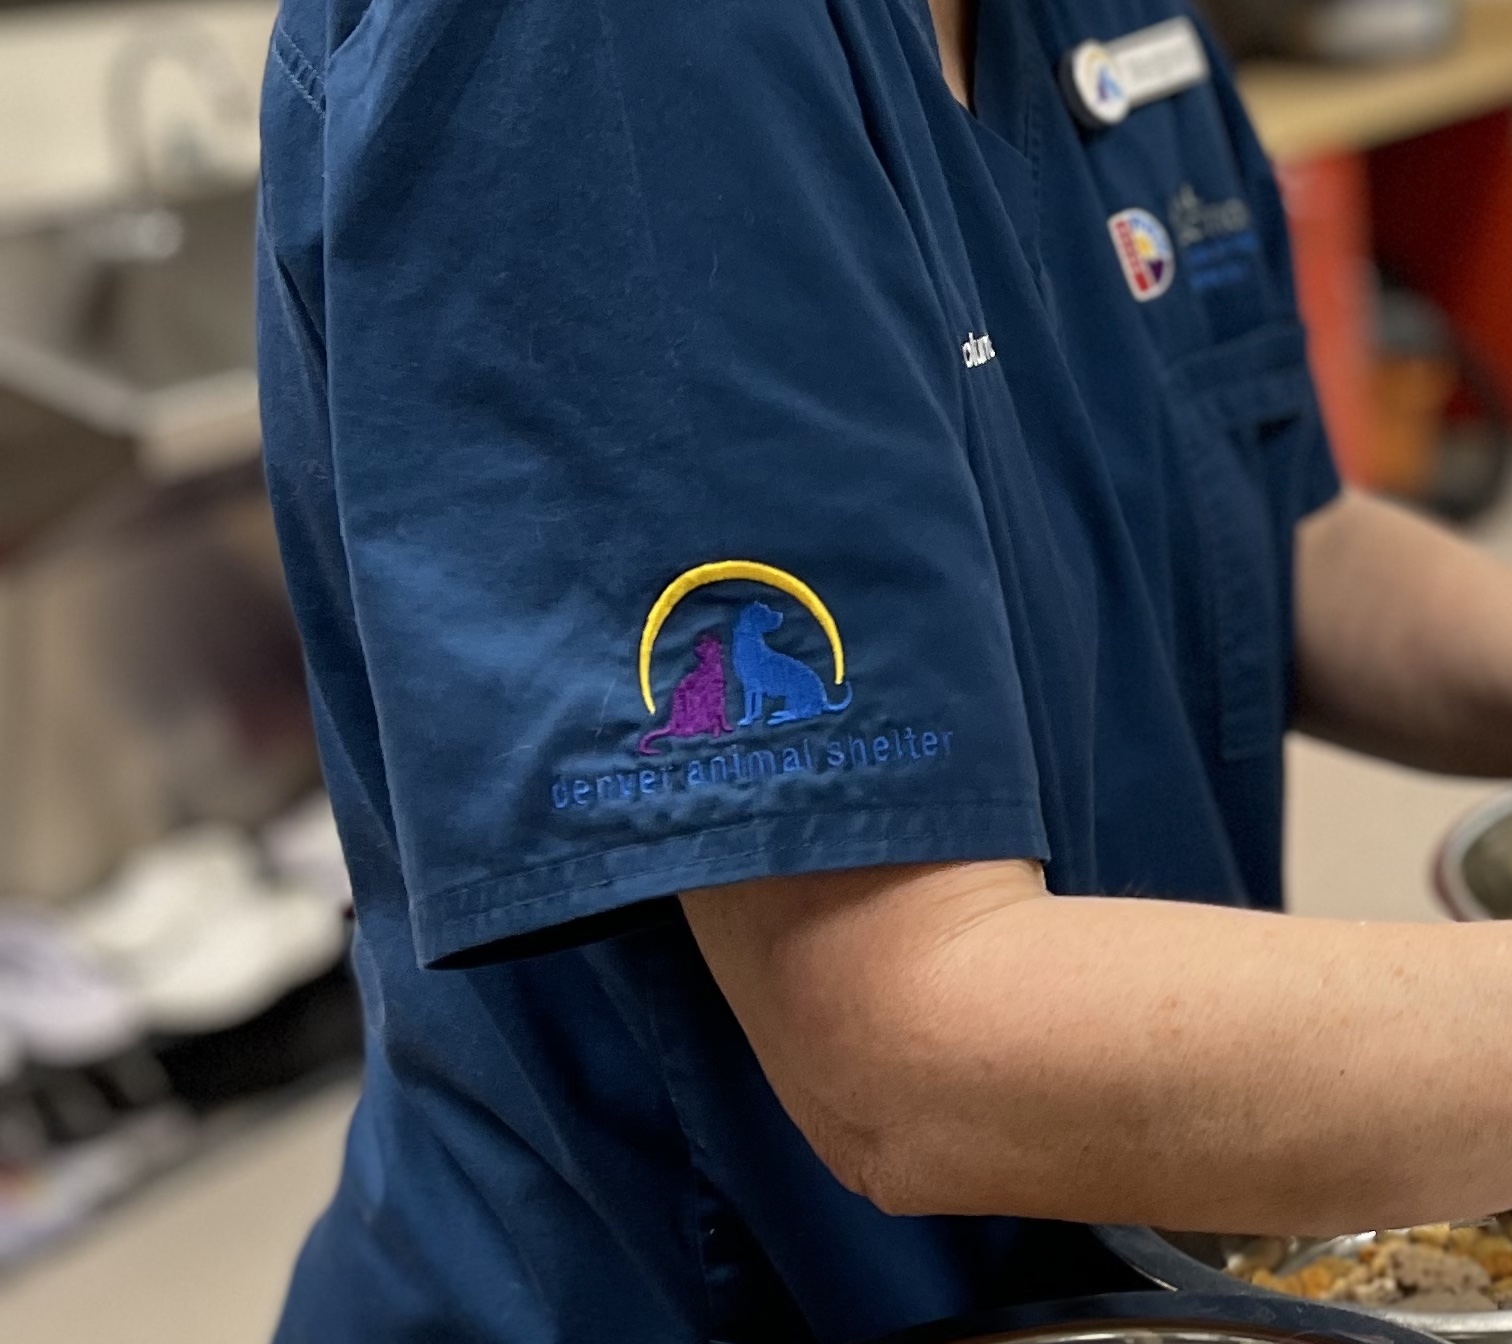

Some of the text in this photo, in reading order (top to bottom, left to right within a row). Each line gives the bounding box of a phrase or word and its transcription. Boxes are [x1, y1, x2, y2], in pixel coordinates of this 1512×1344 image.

[551, 725, 953, 809] denver animal shelter
